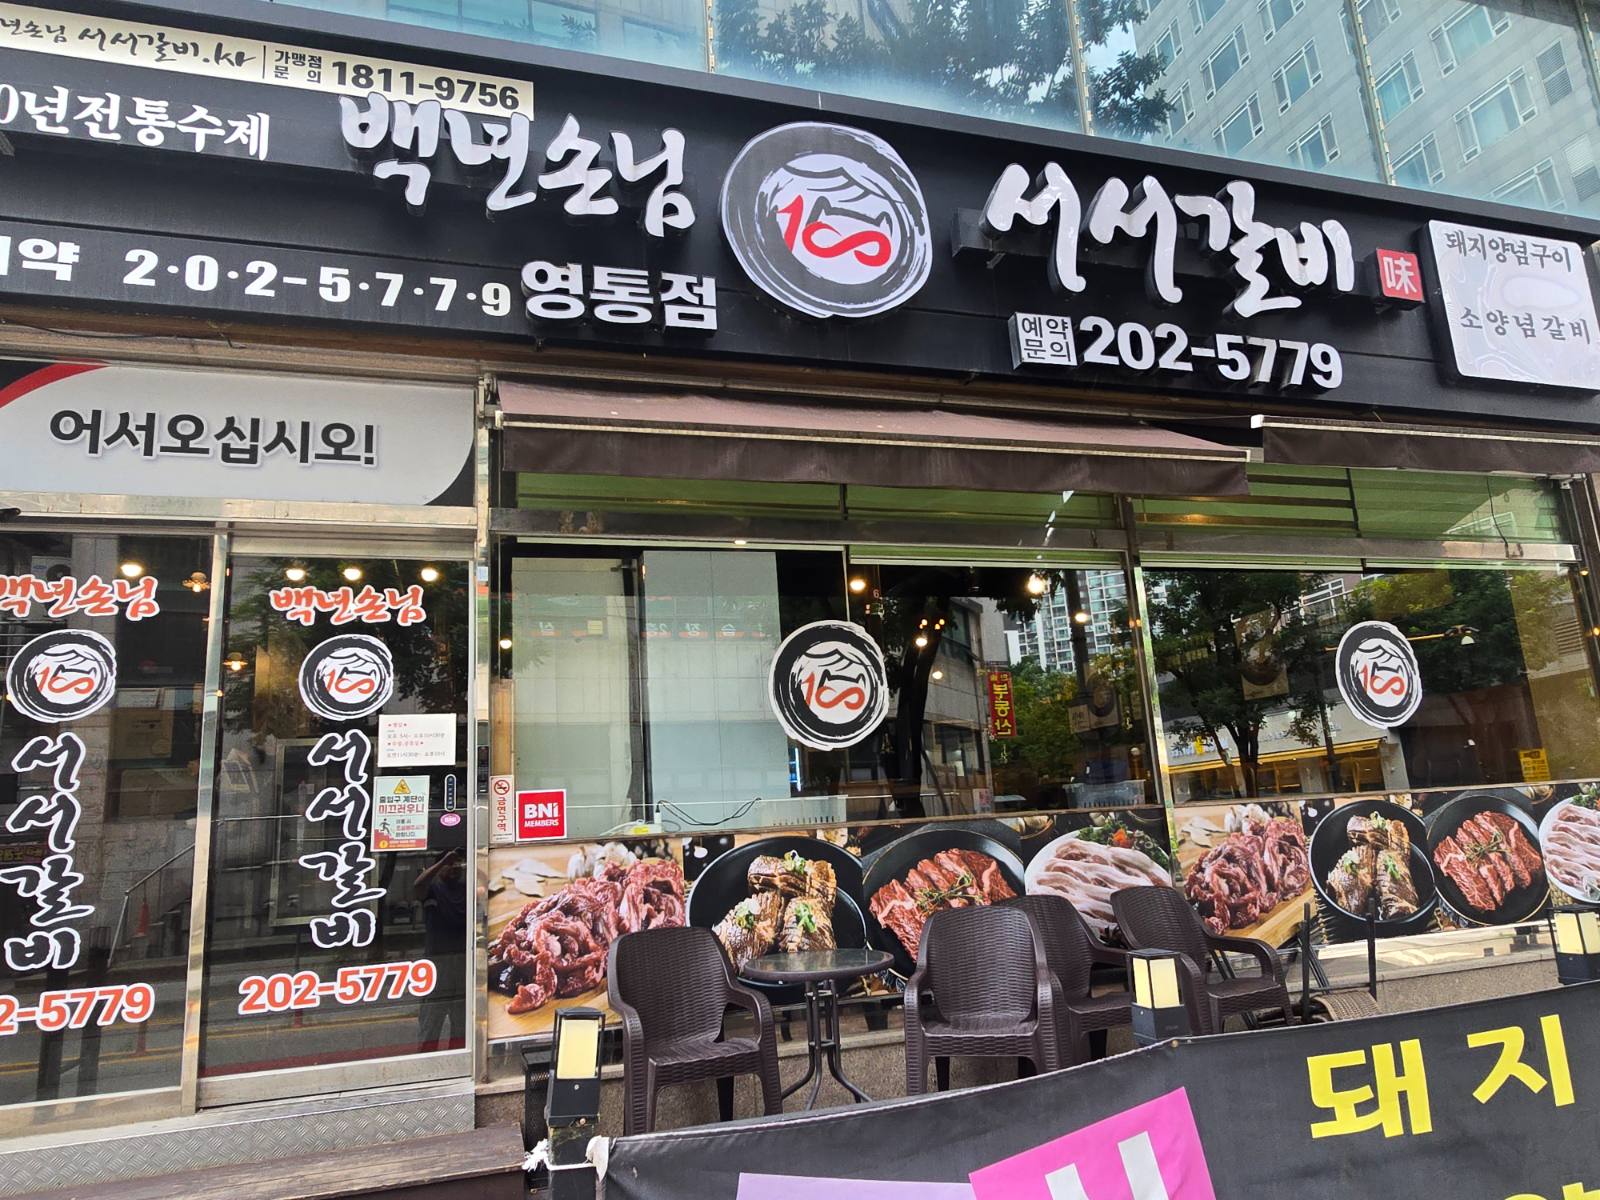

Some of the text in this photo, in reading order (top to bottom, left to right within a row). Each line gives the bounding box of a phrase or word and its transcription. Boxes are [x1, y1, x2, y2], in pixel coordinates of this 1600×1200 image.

[273, 65, 322, 85] 문의
[274, 49, 322, 68] 가맹점
[331, 60, 520, 110] 1811-9756
[338, 91, 696, 237] 백년손님
[0, 235, 80, 281] 약
[984, 160, 1355, 318] 서서갈비
[1444, 229, 1572, 272] 돼지양념구이
[521, 260, 718, 331] 영통점
[1383, 256, 1418, 295] 味
[1021, 316, 1069, 340] 예약
[1460, 306, 1590, 345] 소양념갈비
[1023, 338, 1072, 362] 문의
[1079, 315, 1343, 389] 202-5779
[49, 408, 376, 466] 어서오십시오!
[270, 585, 426, 626] 백년손님
[300, 729, 388, 948] 서서갈비
[523, 818, 560, 828] MEMBERS
[240, 960, 436, 1014] 202-5779
